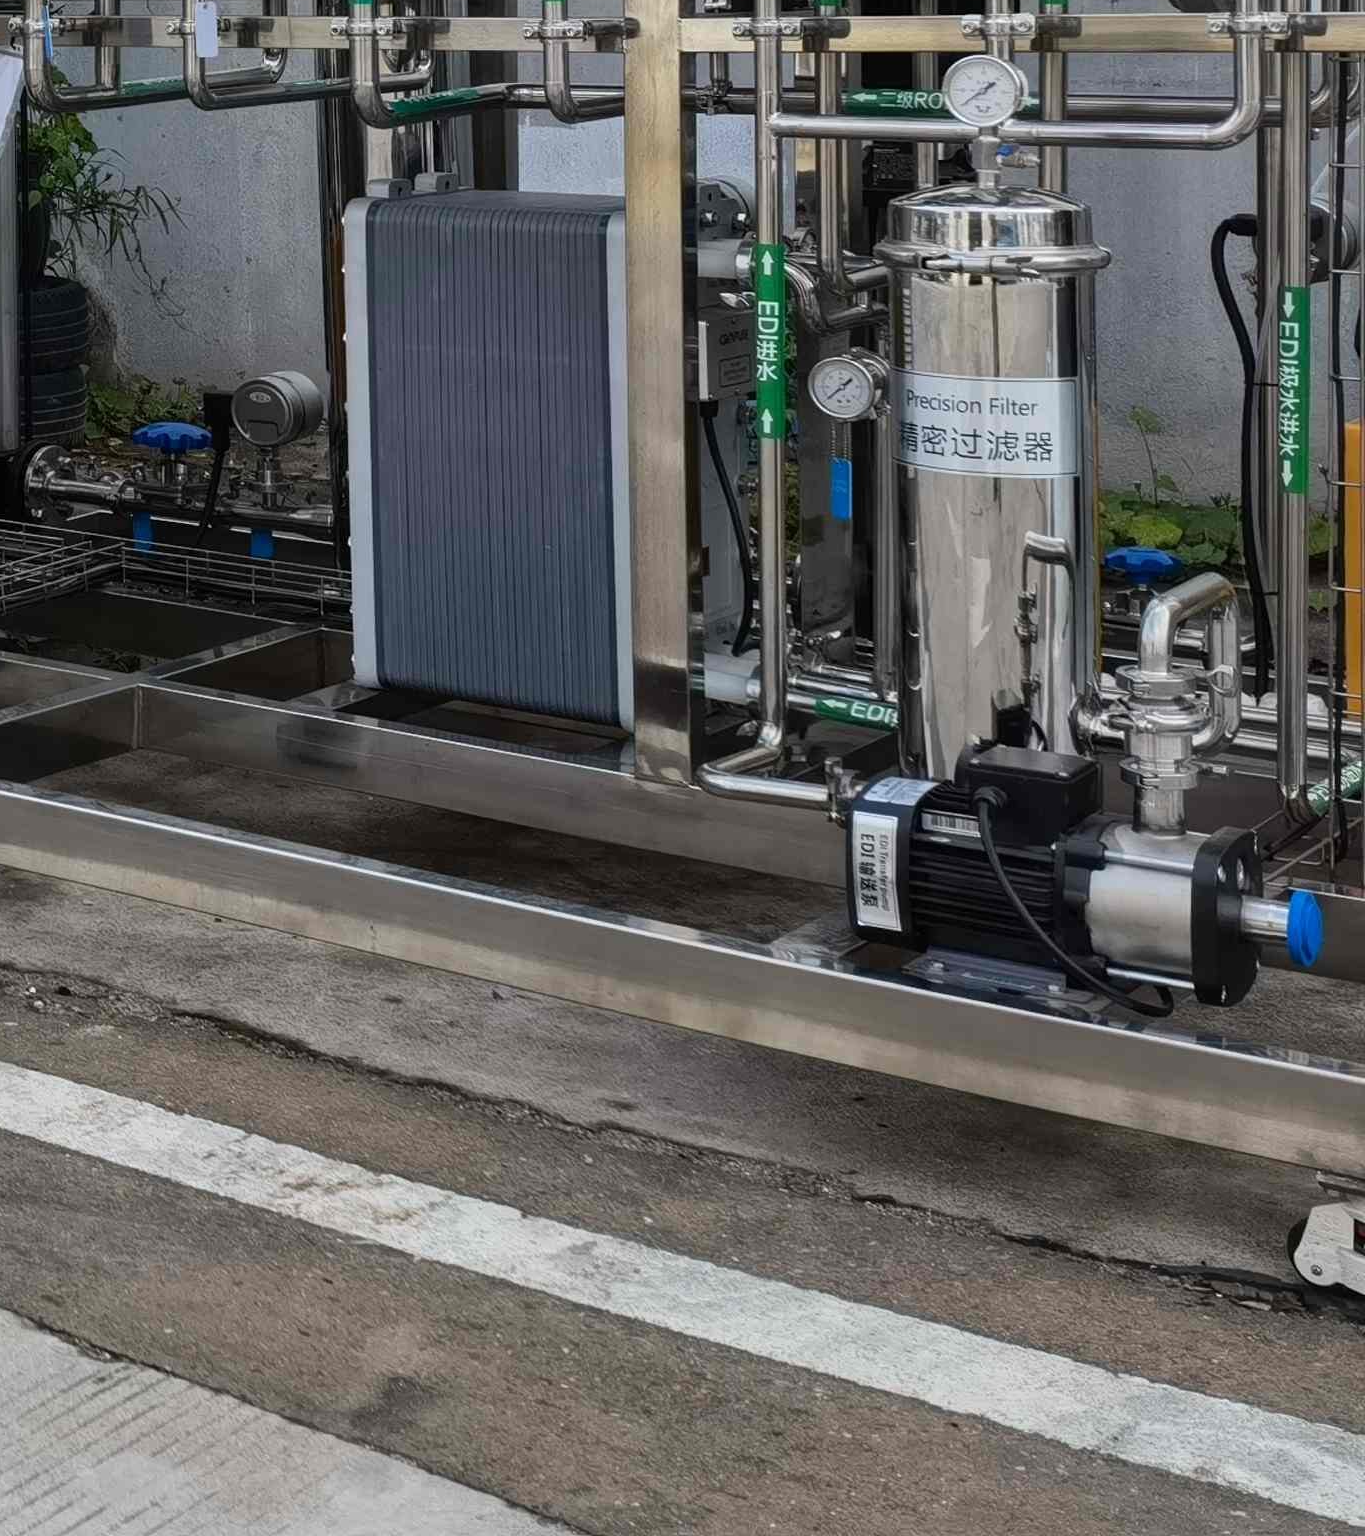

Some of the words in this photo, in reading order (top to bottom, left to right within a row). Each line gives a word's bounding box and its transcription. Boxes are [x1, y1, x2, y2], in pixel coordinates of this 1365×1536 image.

[757, 300, 779, 381] EDI进水
[907, 388, 982, 415] Precision
[989, 397, 1039, 418] Filter
